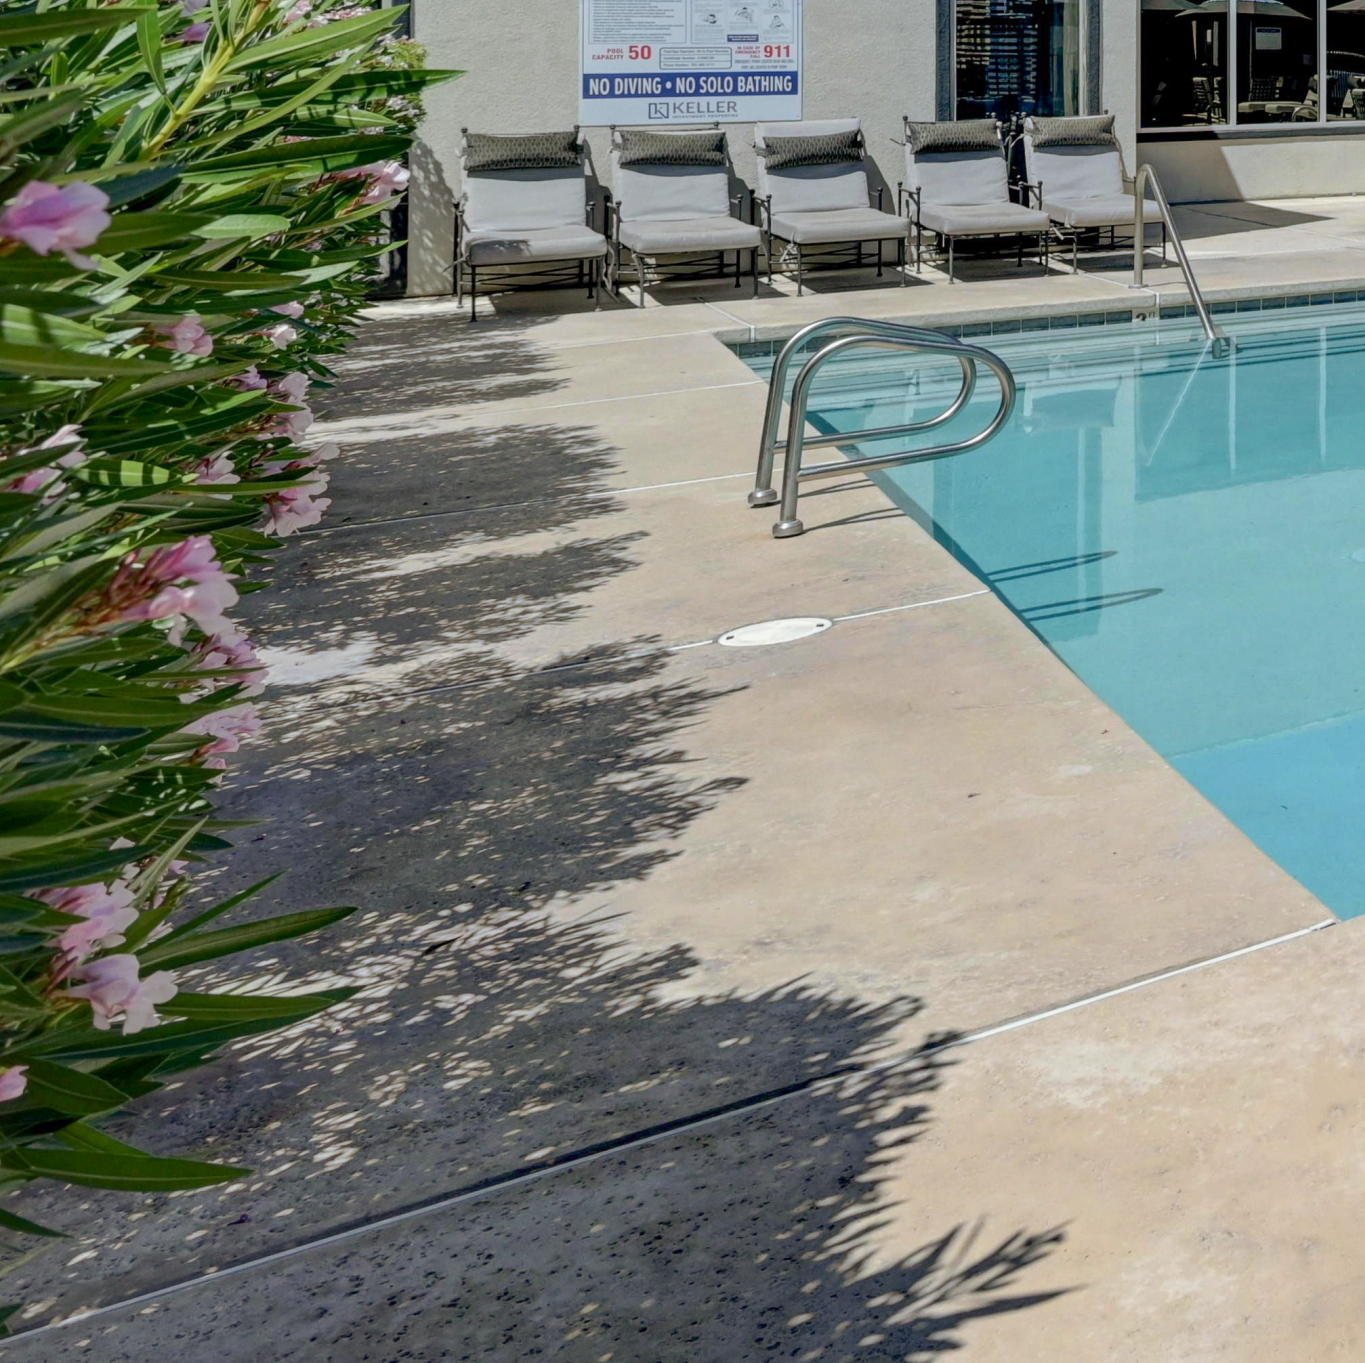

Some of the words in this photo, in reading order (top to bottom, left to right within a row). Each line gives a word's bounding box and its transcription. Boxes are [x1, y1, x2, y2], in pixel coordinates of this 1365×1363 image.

[629, 45, 652, 60] 50
[763, 45, 791, 58] 911
[589, 78, 610, 95] NO
[614, 77, 662, 94] DIVING
[676, 77, 696, 94] NO
[700, 76, 733, 93] SOLO
[737, 75, 793, 93] BATHING
[673, 101, 738, 114] KELLER
